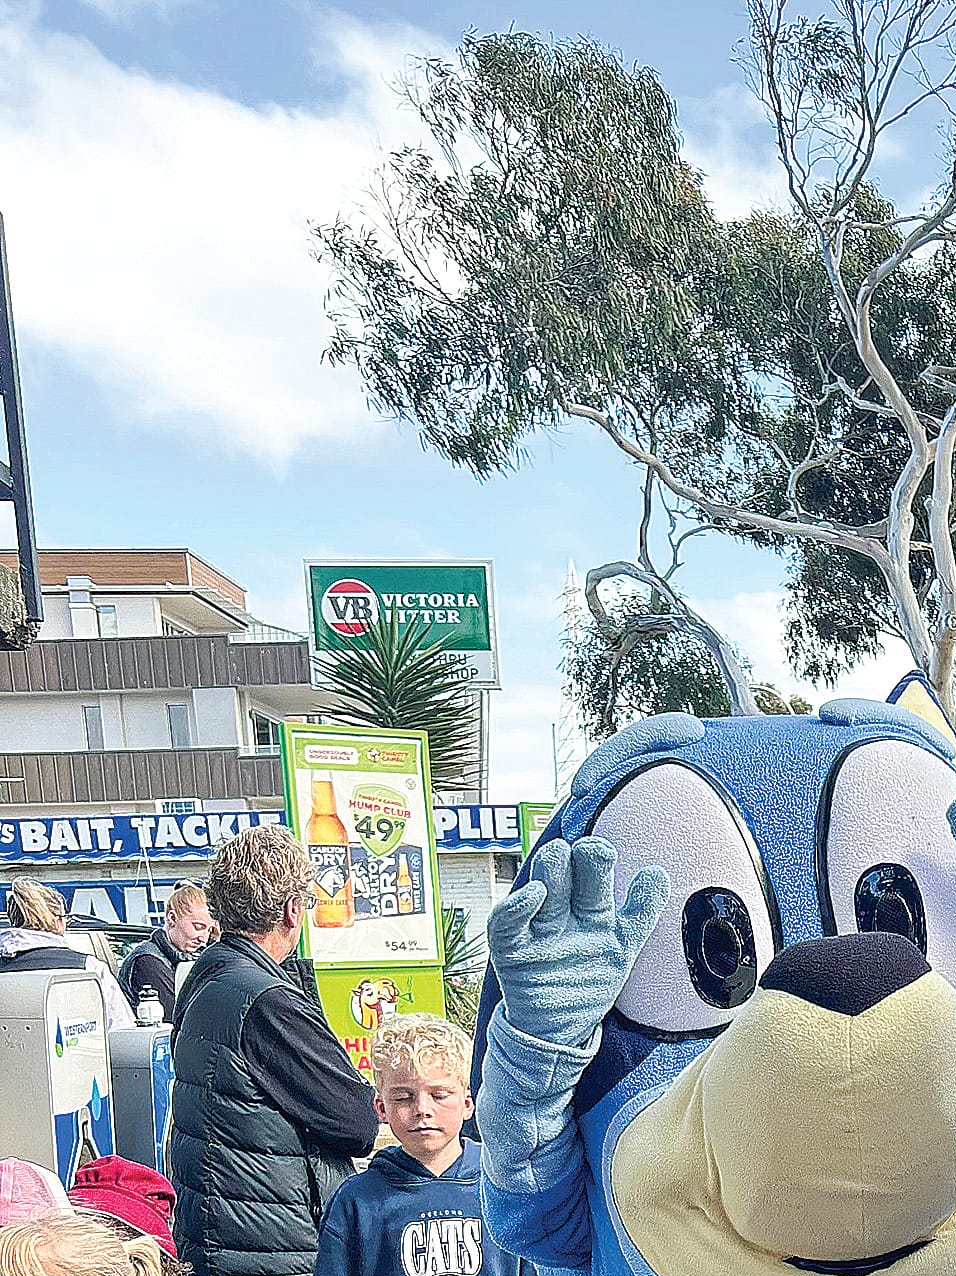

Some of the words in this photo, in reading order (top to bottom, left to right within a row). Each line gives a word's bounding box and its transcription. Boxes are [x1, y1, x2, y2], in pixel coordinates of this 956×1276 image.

[327, 595, 373, 620] VB
[380, 593, 480, 608] VICTORIA
[349, 800, 381, 812] HUMP
[383, 807, 411, 818] CLUB
[311, 853, 347, 866] DRY
